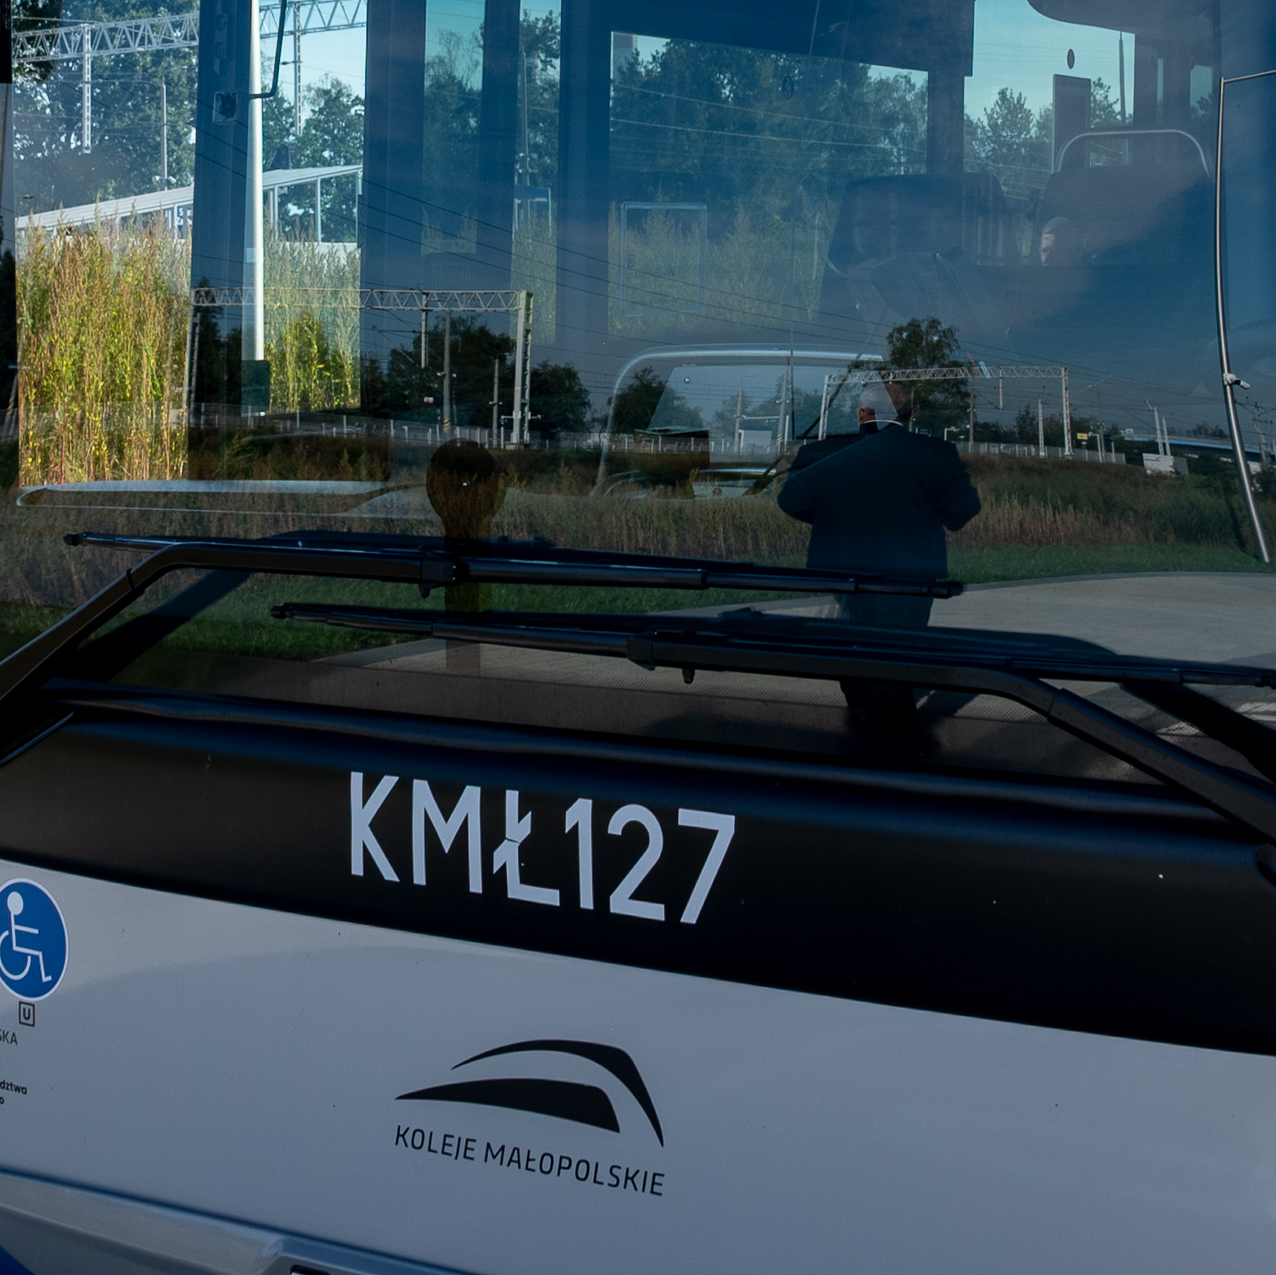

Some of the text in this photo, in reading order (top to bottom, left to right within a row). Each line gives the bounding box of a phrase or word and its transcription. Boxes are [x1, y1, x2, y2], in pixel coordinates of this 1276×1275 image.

[349, 771, 736, 925] KMŁ127
[394, 1124, 666, 1197] KOLEJE MAŁOPOLSKIE
